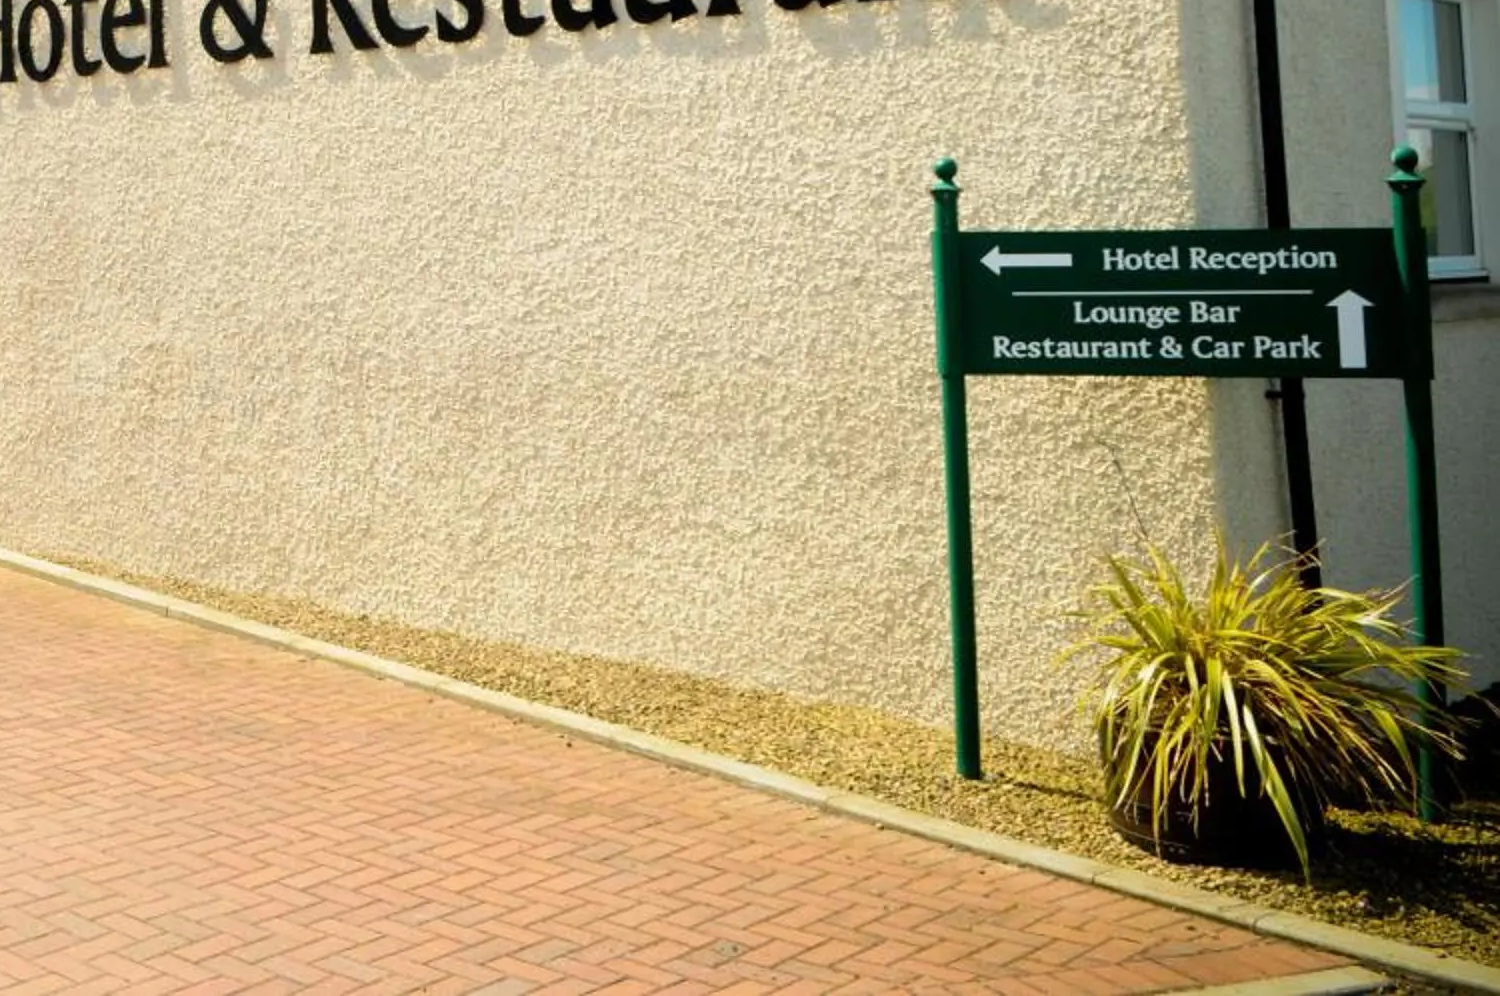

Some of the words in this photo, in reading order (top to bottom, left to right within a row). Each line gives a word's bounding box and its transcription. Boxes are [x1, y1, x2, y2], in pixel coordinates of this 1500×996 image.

[1102, 246, 1180, 271] Hotel
[1189, 245, 1337, 275] Reception
[1073, 301, 1180, 328] Lounge
[1190, 301, 1240, 324] Bar
[992, 336, 1151, 360] Restaurant
[1160, 336, 1184, 359] &
[1191, 336, 1244, 359] Car
[1254, 335, 1322, 360] Park
